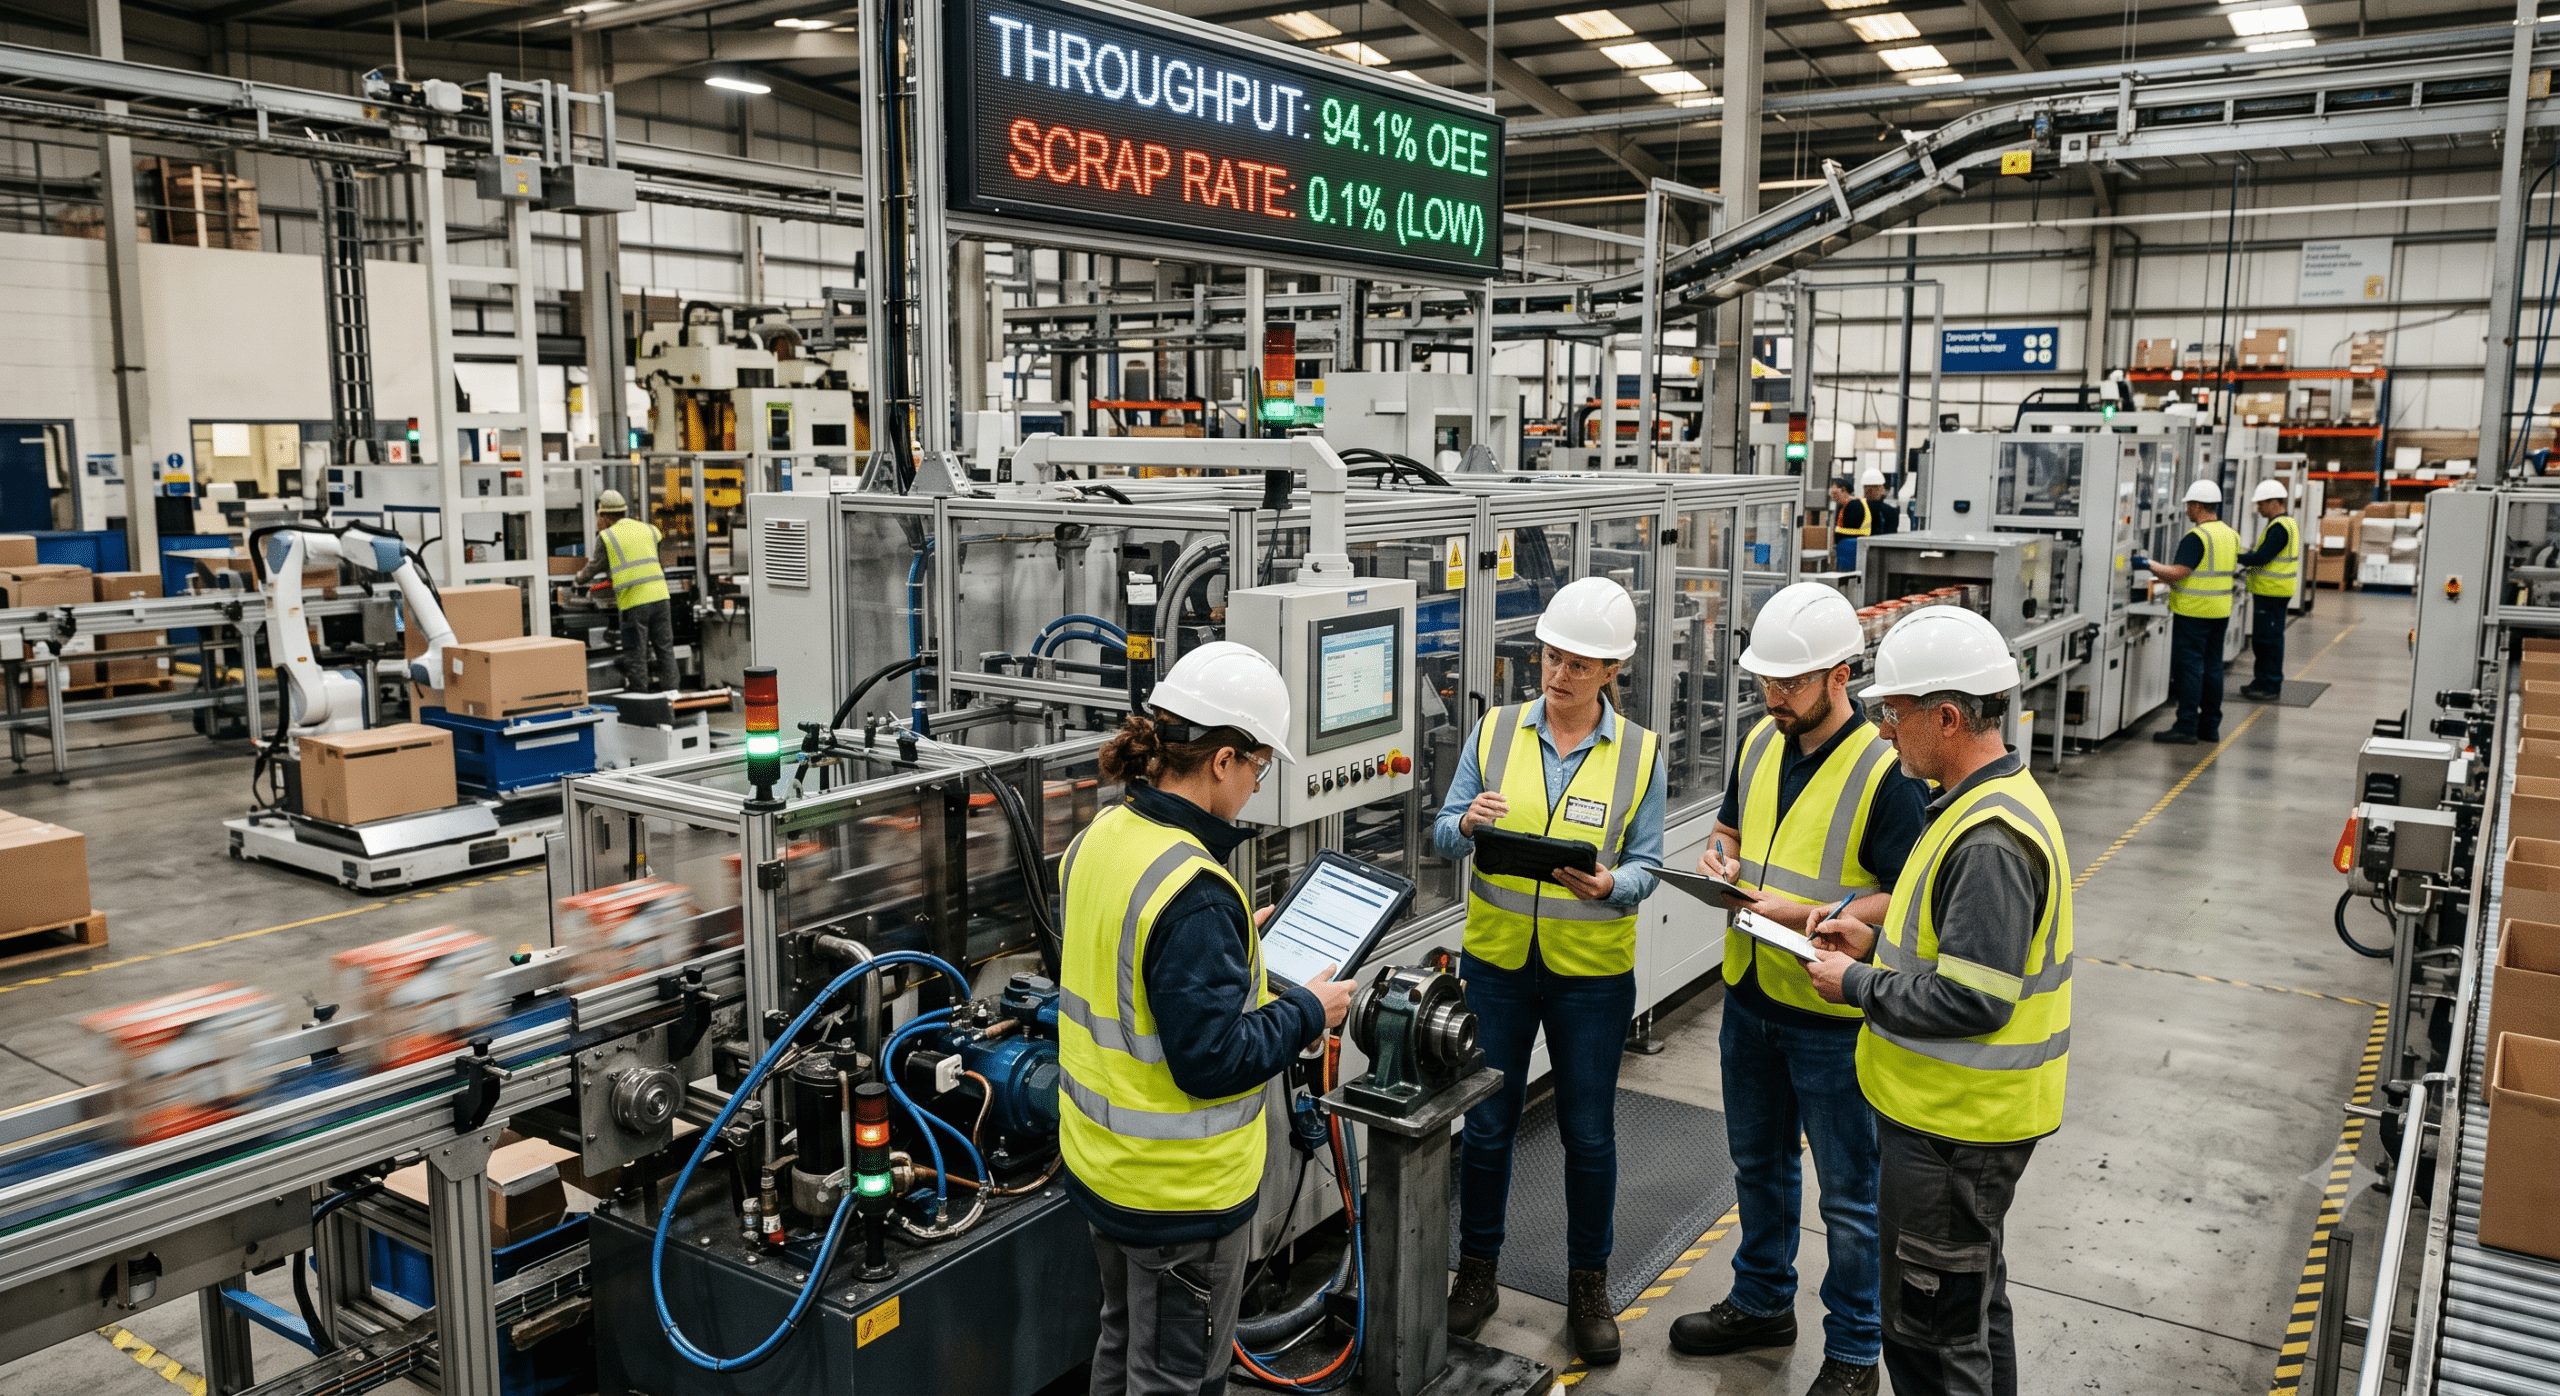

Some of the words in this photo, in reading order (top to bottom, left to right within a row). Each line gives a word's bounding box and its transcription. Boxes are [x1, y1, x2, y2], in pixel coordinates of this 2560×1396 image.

[988, 14, 1311, 140] THROUGHPUT:
[1322, 98, 1417, 162] 94.1%
[1427, 124, 1488, 177] OEE
[1008, 118, 1171, 196] SCRAP
[1183, 150, 1297, 218] RATE:
[1308, 176, 1386, 232] 0.1%
[1397, 192, 1485, 256] (LOW)
